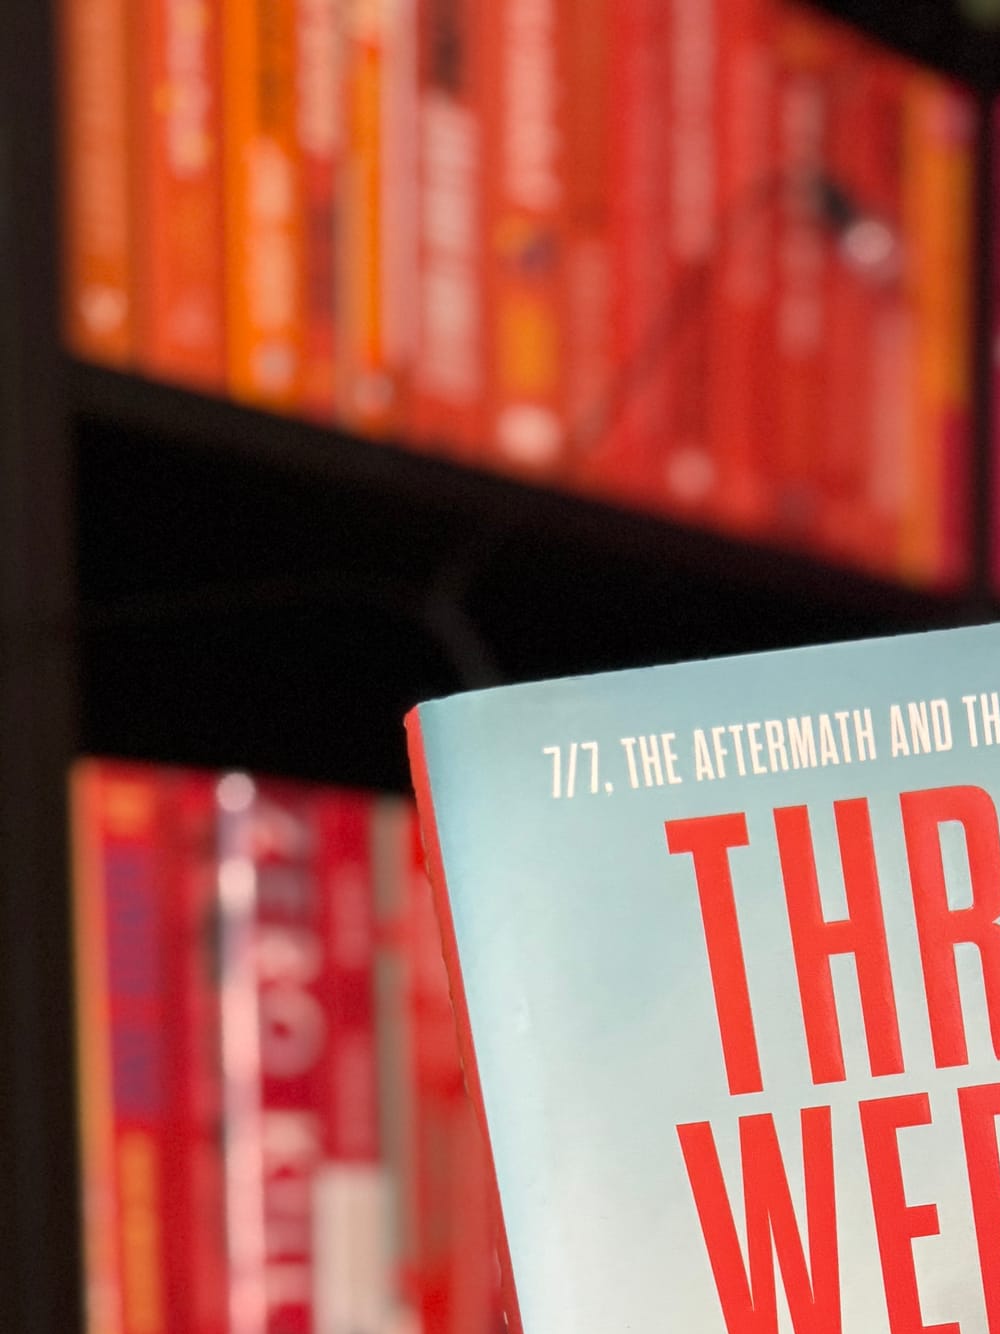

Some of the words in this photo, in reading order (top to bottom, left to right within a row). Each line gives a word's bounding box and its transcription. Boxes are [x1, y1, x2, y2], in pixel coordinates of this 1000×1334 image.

[619, 731, 684, 790] THE
[692, 707, 878, 782] AFTERMATH
[889, 694, 954, 758] AND
